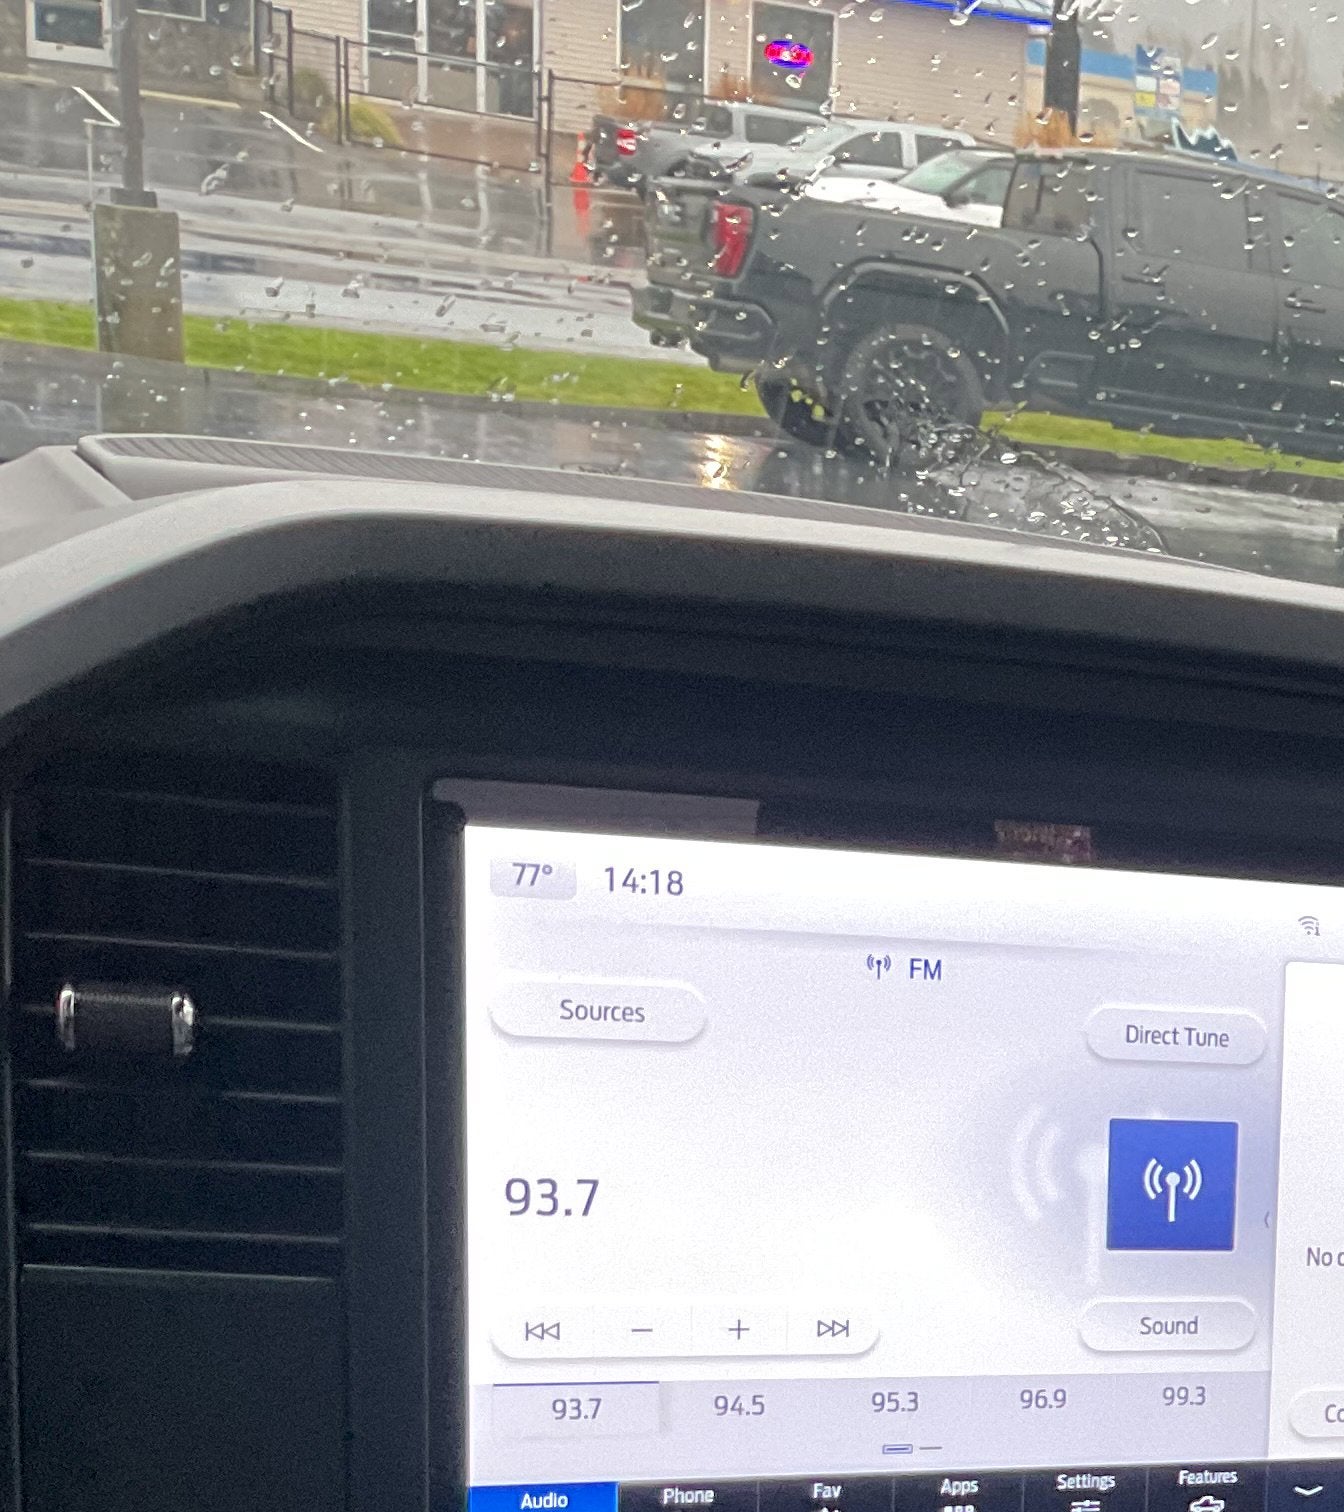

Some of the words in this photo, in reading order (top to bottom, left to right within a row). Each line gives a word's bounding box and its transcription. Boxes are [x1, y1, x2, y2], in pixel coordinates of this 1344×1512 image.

[512, 862, 553, 887] 77°
[604, 867, 684, 896] 14:18
[909, 958, 943, 981] FM
[559, 999, 646, 1023] Sources
[1125, 1025, 1179, 1046] Direct
[1184, 1028, 1230, 1049] Tune
[504, 1177, 600, 1217] 93.7
[1306, 1248, 1332, 1267] No
[1139, 1315, 1199, 1337] Sound
[713, 1394, 766, 1417] 94.5
[871, 1391, 920, 1413] 95.3
[1020, 1388, 1068, 1410] 96.9
[1162, 1385, 1207, 1407] 99.3
[551, 1397, 602, 1421] 93.7
[940, 1478, 980, 1498] Apps
[1056, 1473, 1116, 1492] Settings
[1178, 1468, 1238, 1487] Features
[520, 1492, 569, 1511] Audio
[663, 1486, 715, 1505] Phone
[812, 1481, 842, 1500] Fav
